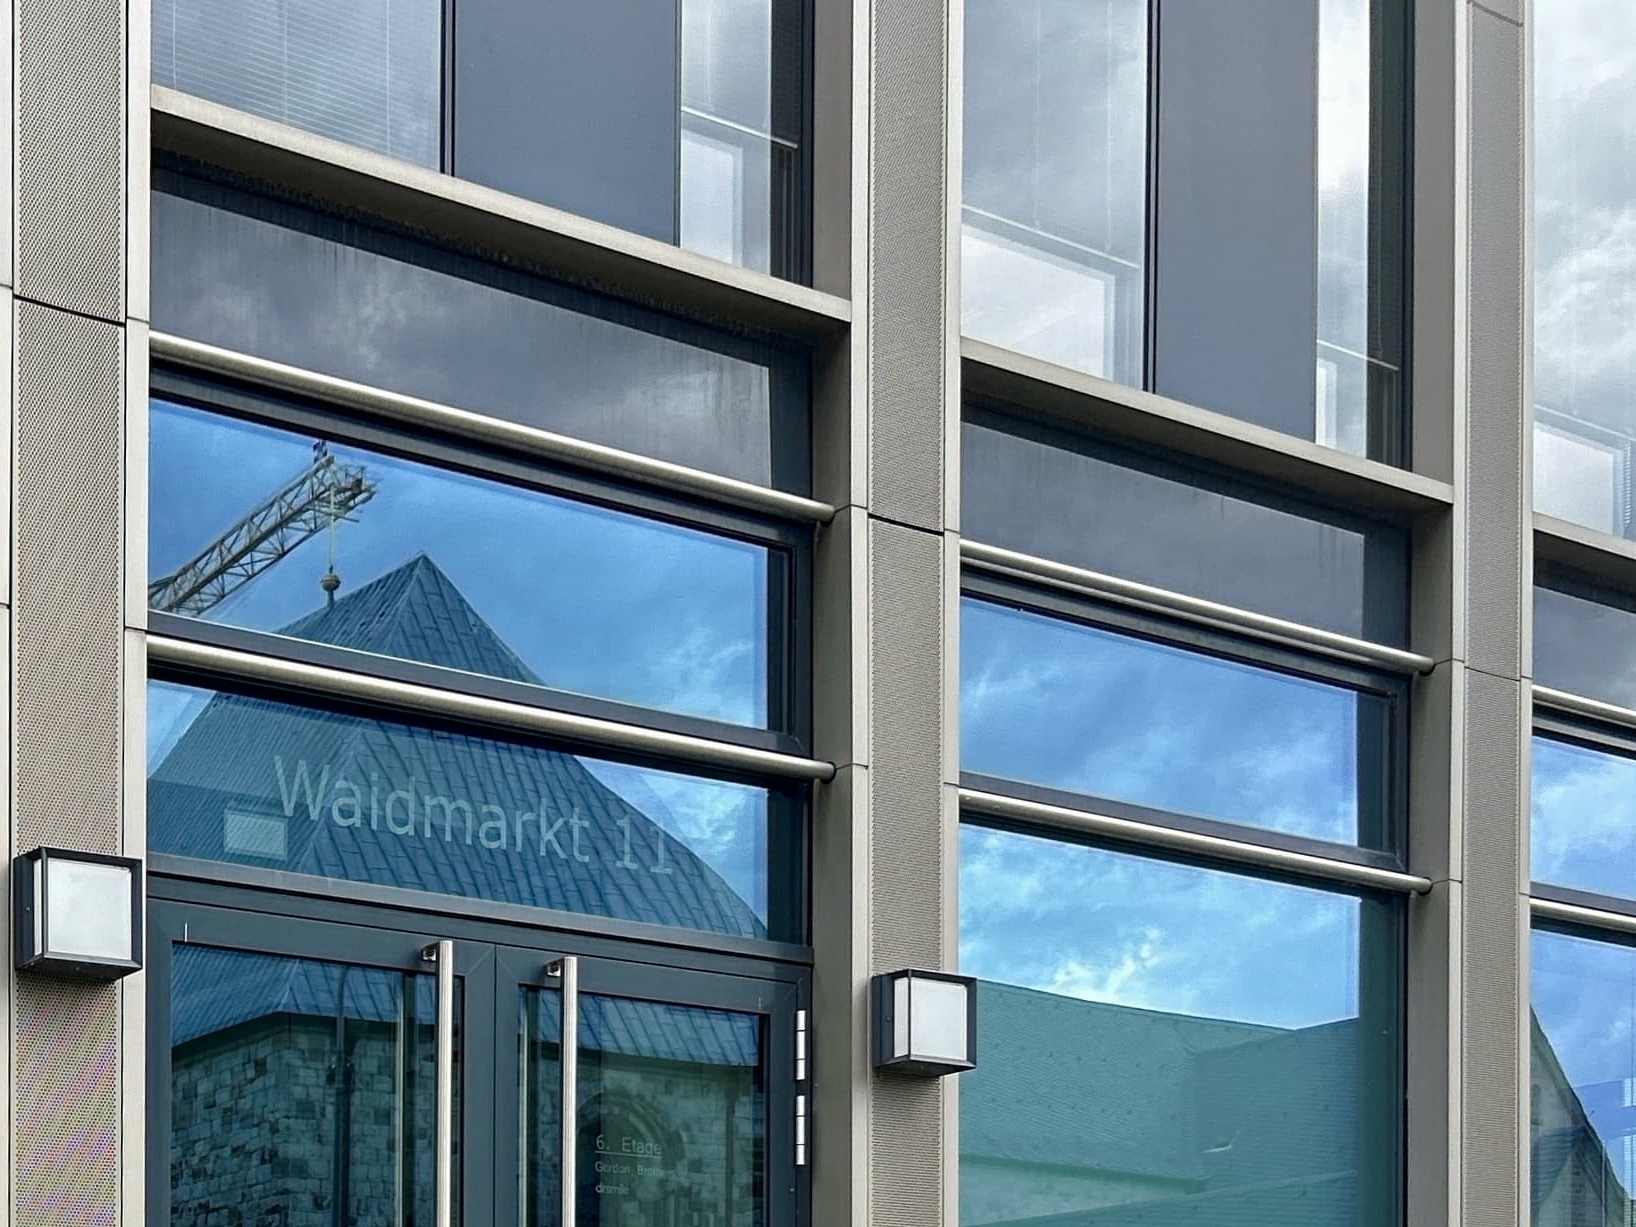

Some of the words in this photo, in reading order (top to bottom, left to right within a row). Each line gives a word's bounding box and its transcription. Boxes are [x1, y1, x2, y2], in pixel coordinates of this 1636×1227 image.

[274, 754, 590, 863] Waidmarkt
[614, 815, 674, 875] 11
[621, 1136, 662, 1157] Etage
